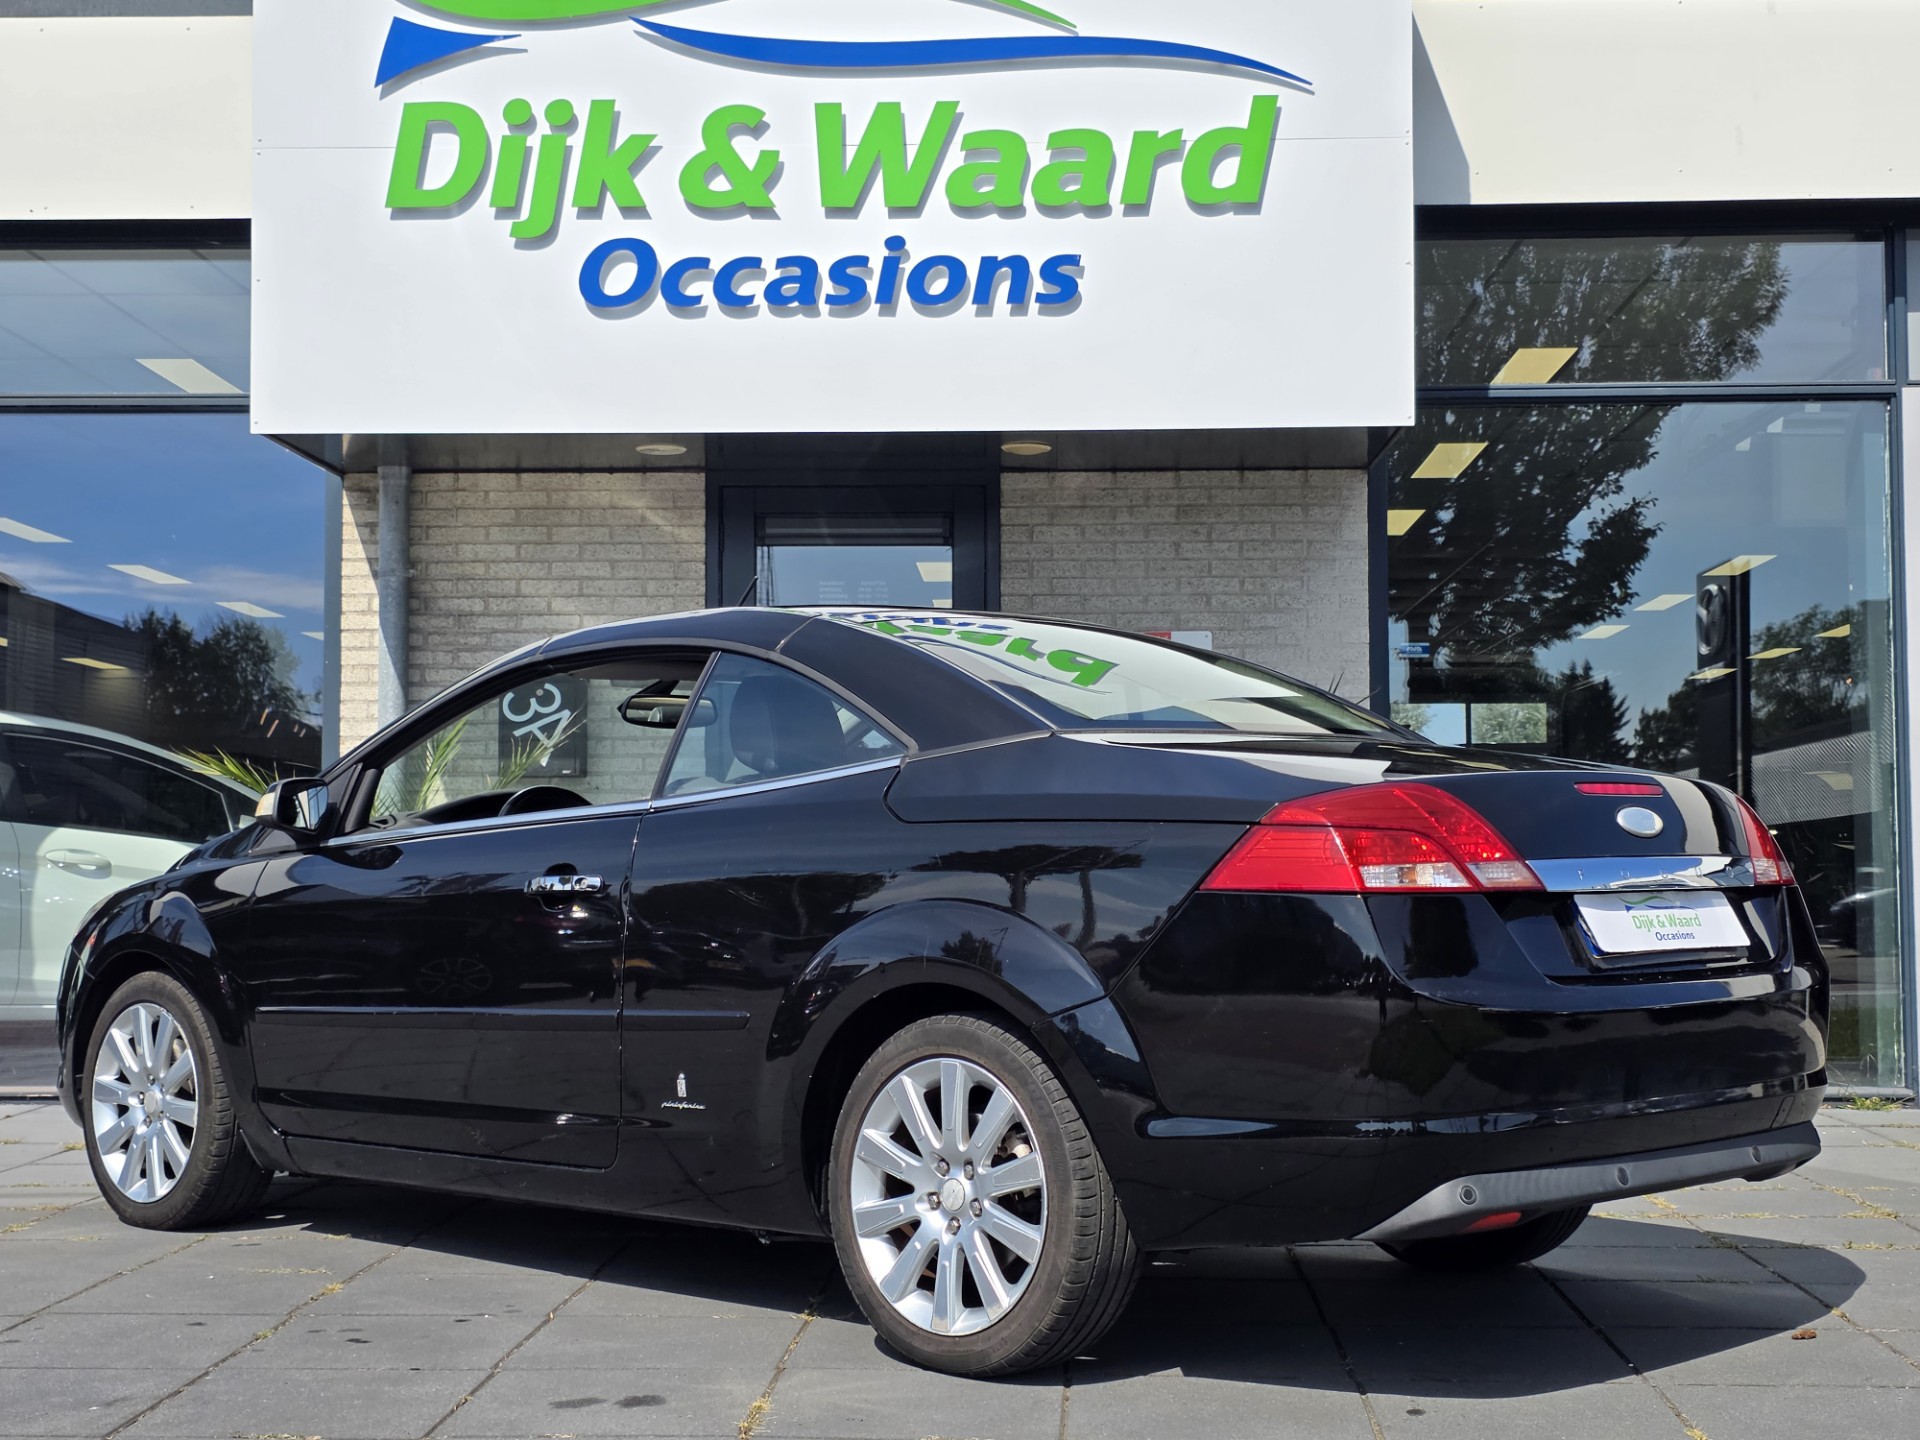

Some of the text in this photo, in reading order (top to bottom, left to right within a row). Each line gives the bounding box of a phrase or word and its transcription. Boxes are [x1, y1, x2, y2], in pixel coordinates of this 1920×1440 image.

[385, 95, 1279, 239] Dijk & Waard
[579, 235, 1082, 308] Occasions
[503, 683, 571, 767] 3A
[1632, 913, 1702, 932] Dijk & Waard
[1655, 931, 1696, 942] Occasions
